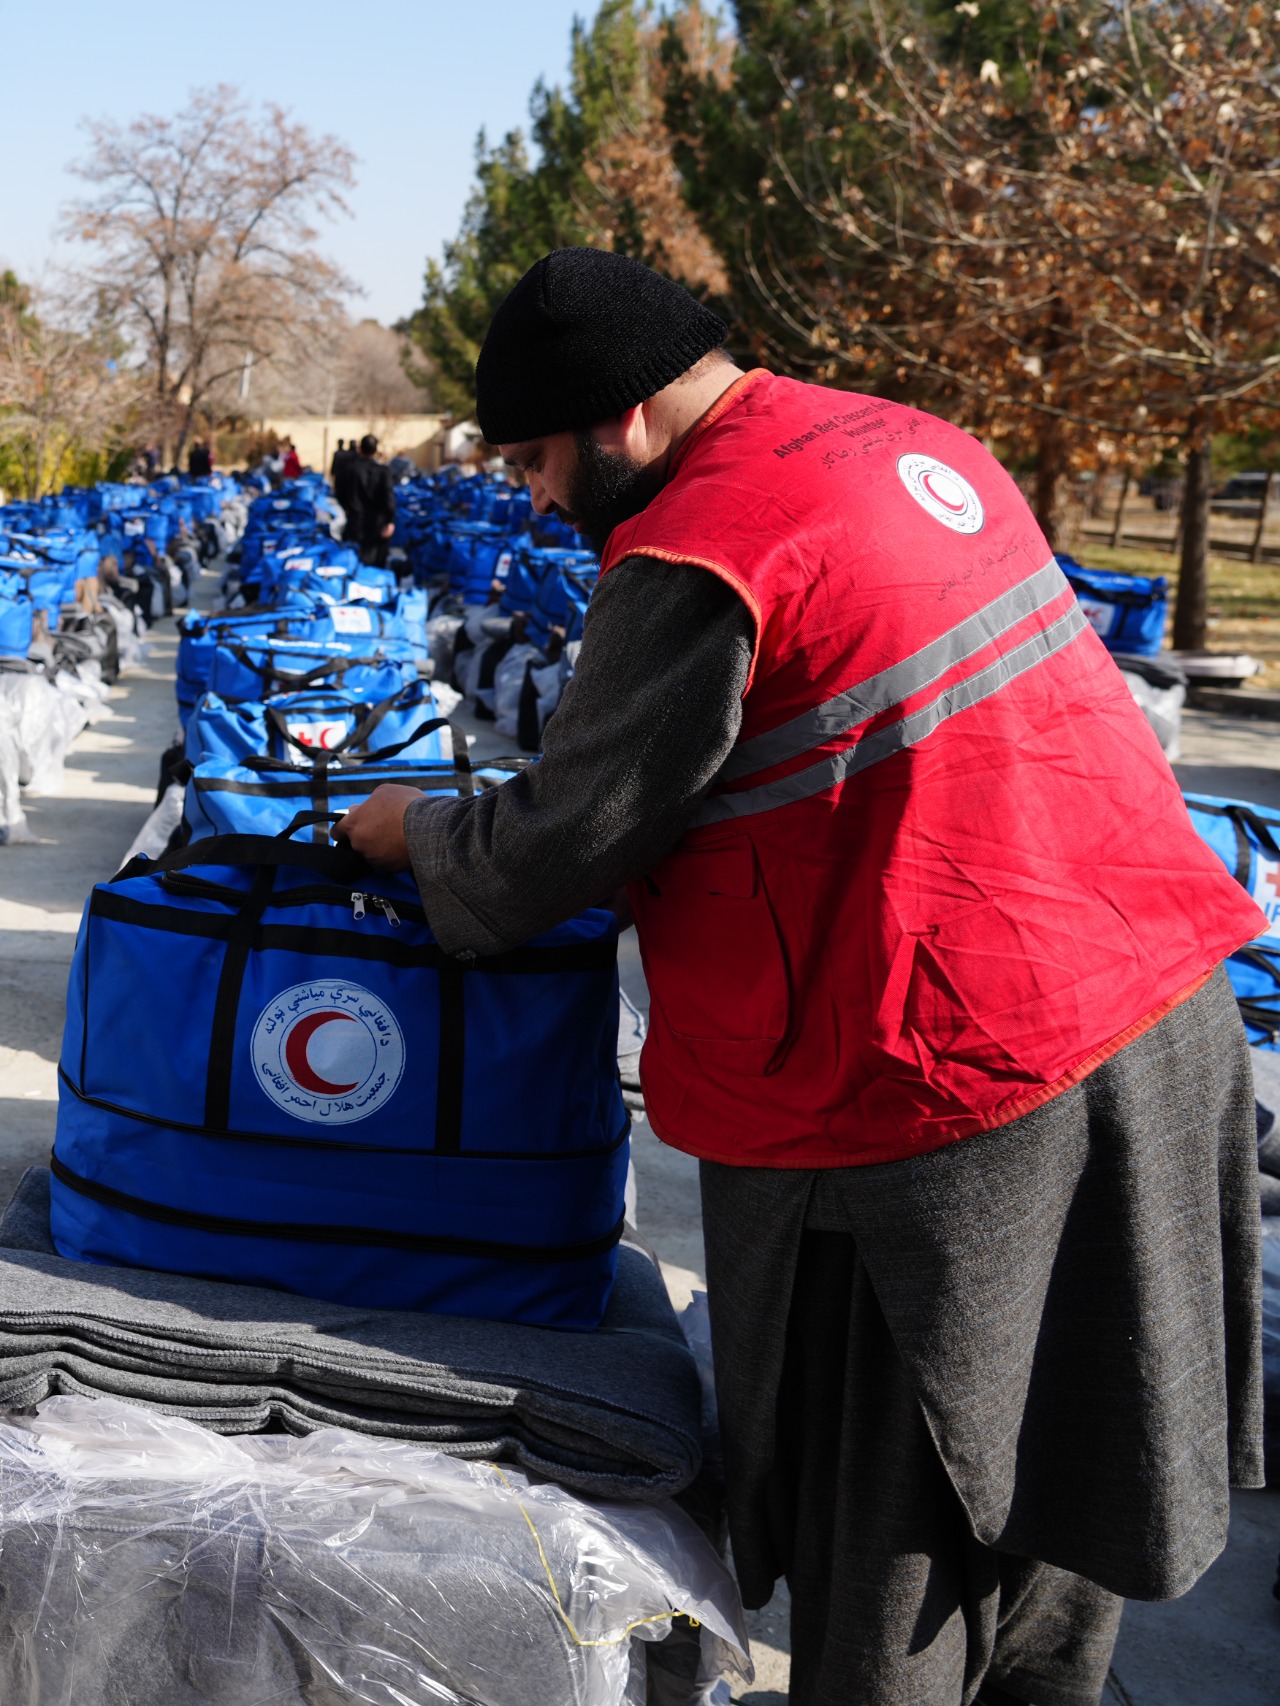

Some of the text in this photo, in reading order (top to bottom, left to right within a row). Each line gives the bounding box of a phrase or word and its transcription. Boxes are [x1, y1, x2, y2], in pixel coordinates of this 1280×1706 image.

[773, 438, 820, 459] Afghan
[812, 418, 840, 434] Red
[833, 405, 878, 425] Crescent
[840, 418, 888, 438] Volunteer
